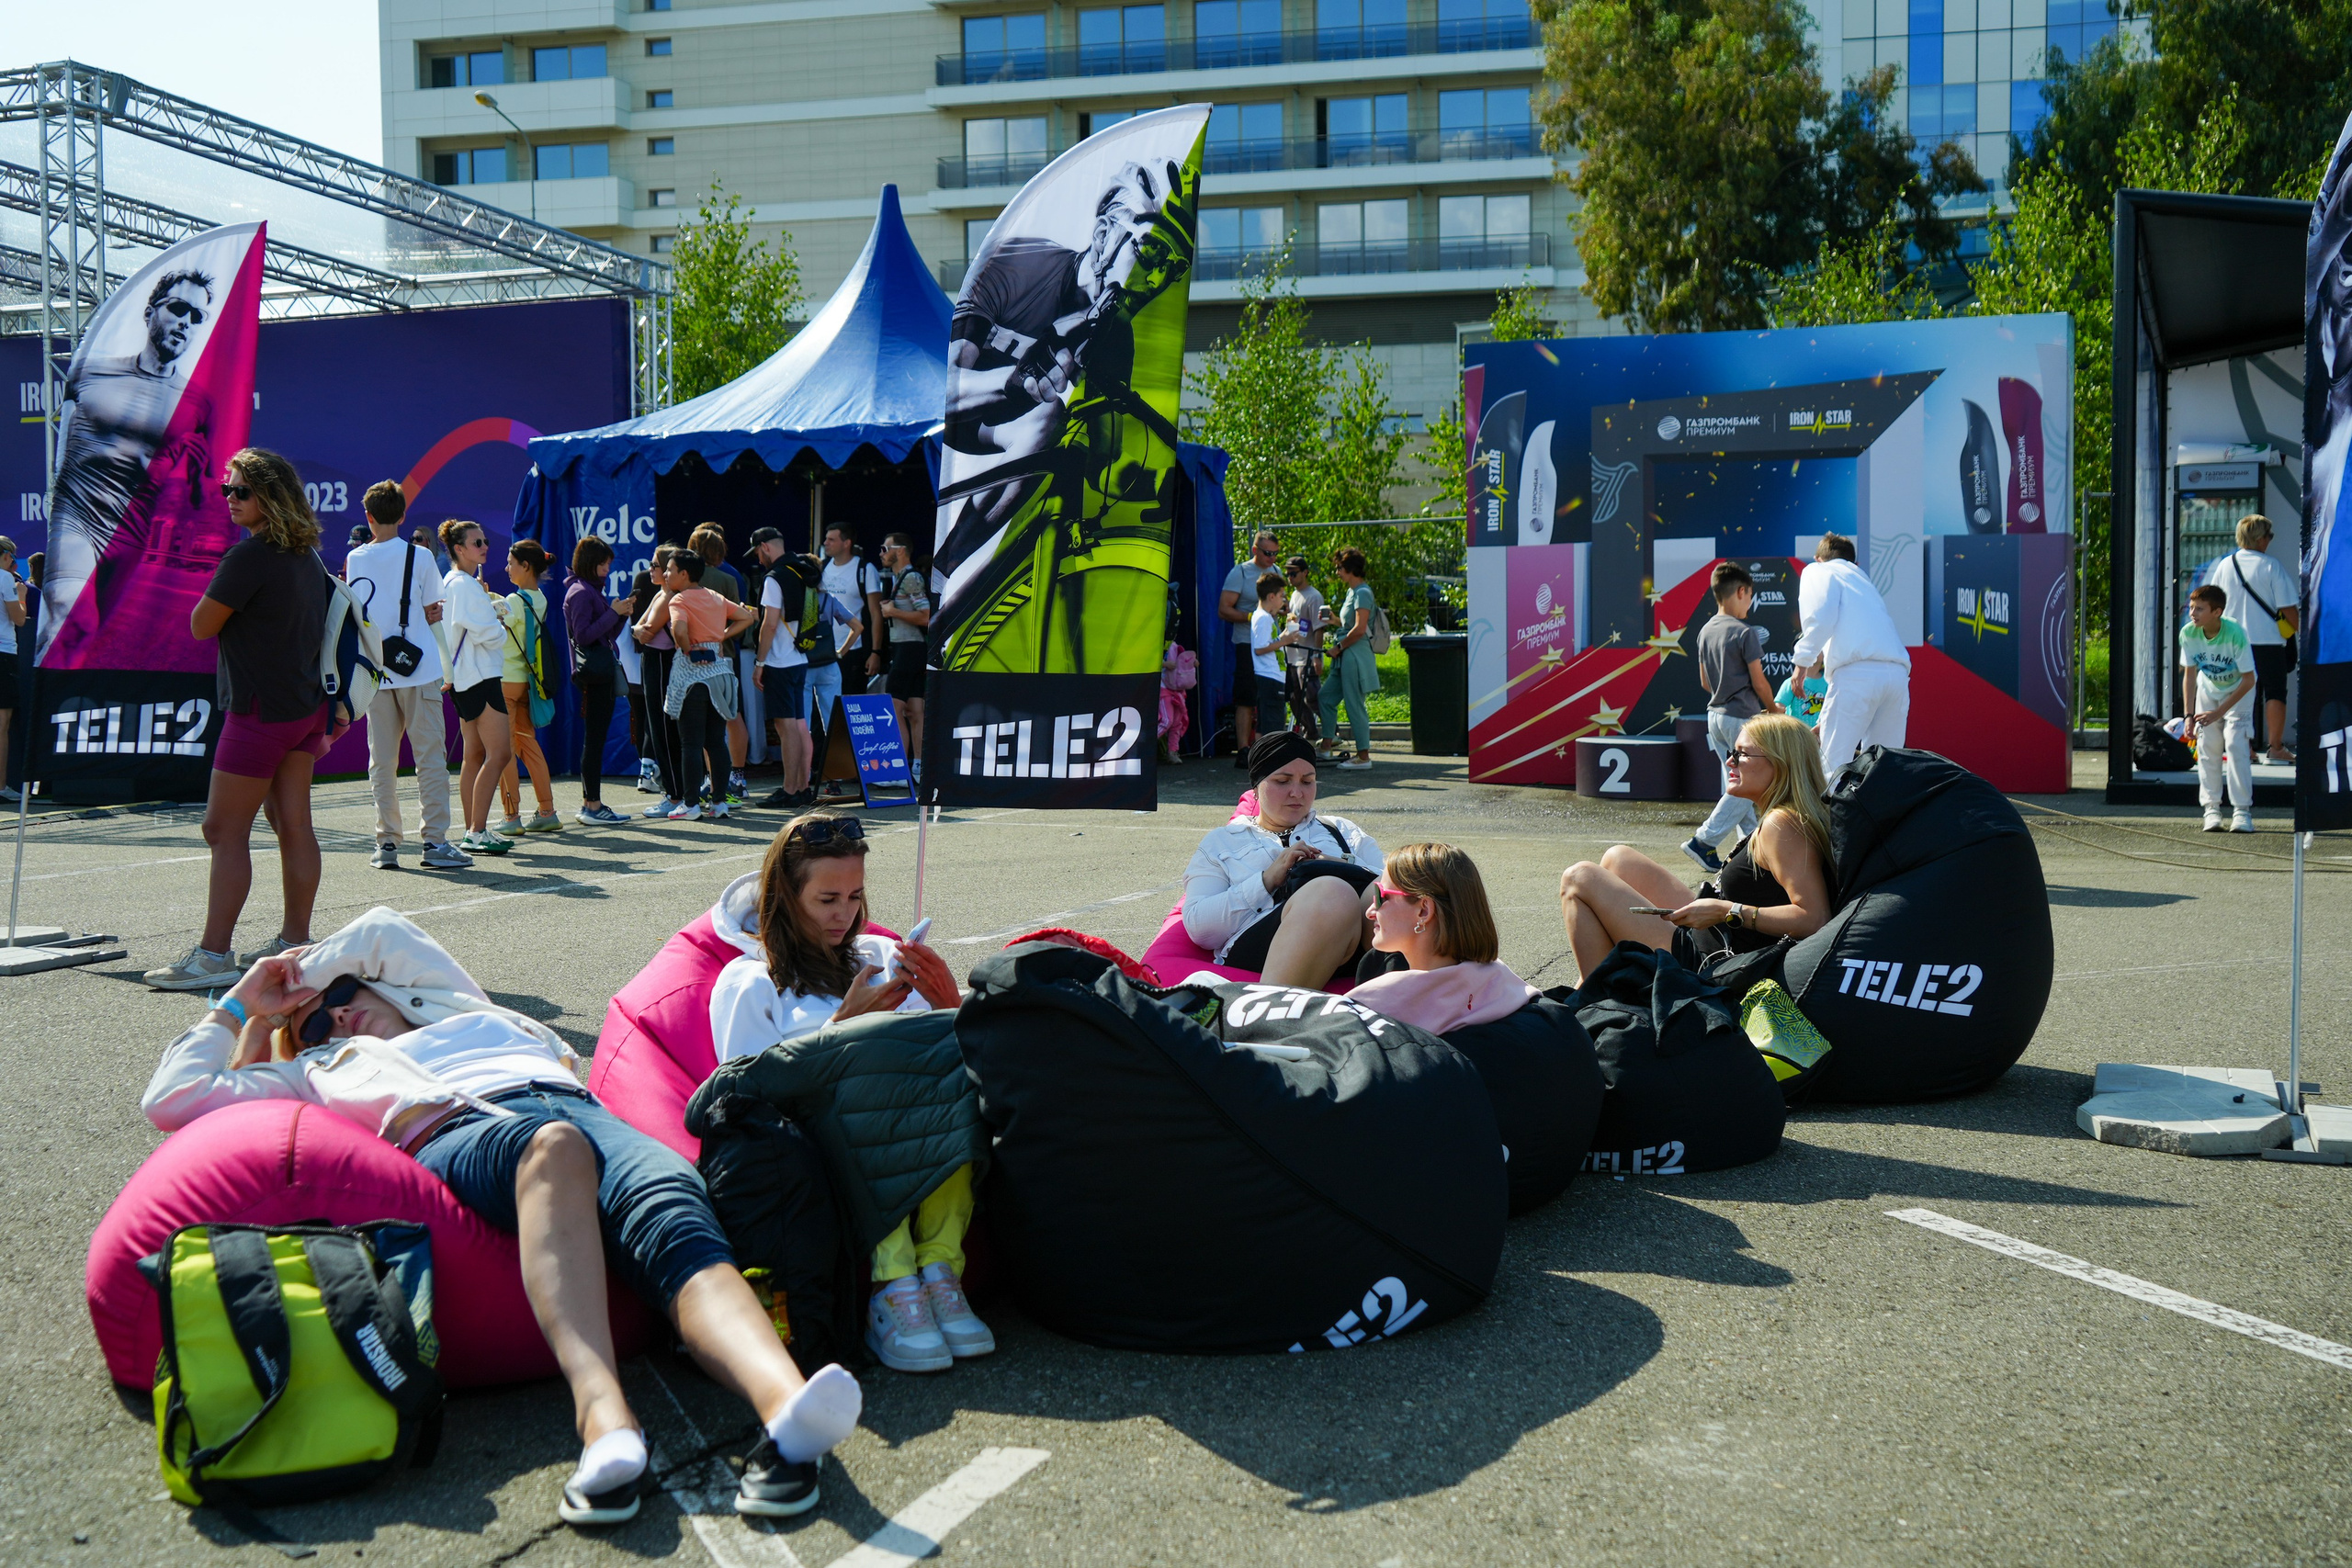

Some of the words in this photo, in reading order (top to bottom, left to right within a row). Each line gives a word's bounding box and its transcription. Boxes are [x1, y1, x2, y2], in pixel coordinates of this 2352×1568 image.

[1686, 415, 1760, 427] ГАЗПРОМБАНК
[1686, 426, 1736, 436] ПРЕМИУМ
[1789, 412, 1815, 426] IRON
[1825, 410, 1852, 424] STAR
[1488, 448, 1501, 484] STAR
[2018, 434, 2029, 499] ГАЗПРОМБАНК
[2027, 455, 2036, 499] ПРЕМИУМ
[304, 480, 348, 513] 023
[1487, 498, 1500, 532] IRON
[1760, 591, 1786, 602] STAR
[1957, 587, 1975, 616] IRON
[1984, 590, 2009, 624] STAR
[1517, 615, 1566, 641] ГАЗПРОМБАНК
[1527, 628, 1560, 650] ПРЕМИУМ
[846, 704, 862, 713] ВАША
[850, 713, 874, 724] ЛЮБИМАЯ
[51, 698, 211, 757] TELE2
[852, 724, 875, 735] КОФЕЙНЯ
[953, 706, 1142, 779] TELE2
[858, 741, 879, 756] Surf
[878, 741, 899, 754] Coffee
[2319, 725, 2352, 794] T
[1599, 748, 1631, 793] 2
[1838, 958, 1984, 1017] TELE2
[356, 1322, 408, 1393] IRONSTAR
